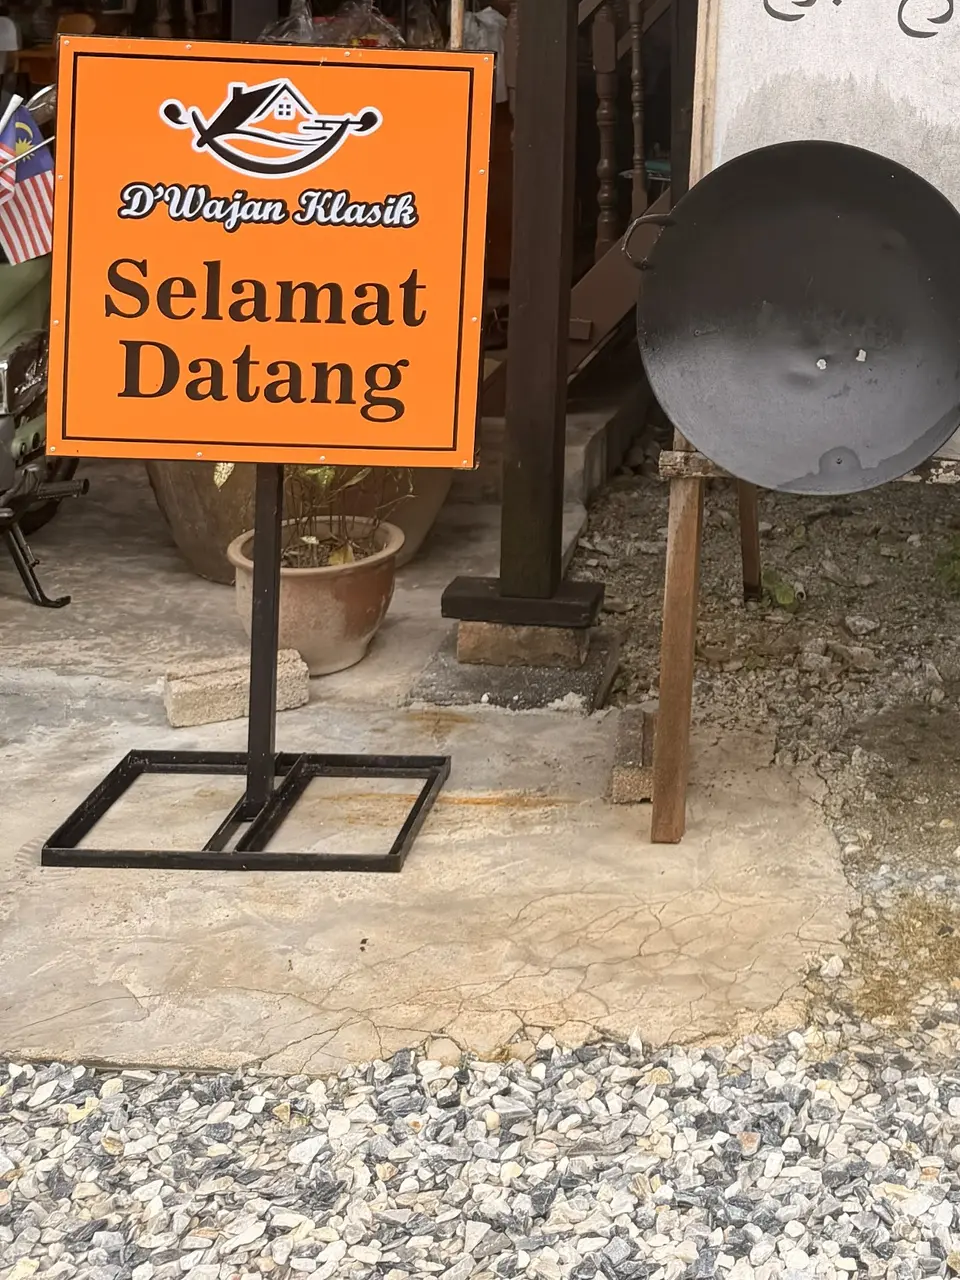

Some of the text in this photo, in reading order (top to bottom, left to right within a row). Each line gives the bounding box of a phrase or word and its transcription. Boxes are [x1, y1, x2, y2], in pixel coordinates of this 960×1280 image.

[118, 181, 419, 233] D'Wajan Klasik
[104, 257, 428, 328] Selamat
[117, 339, 410, 424] Datang
